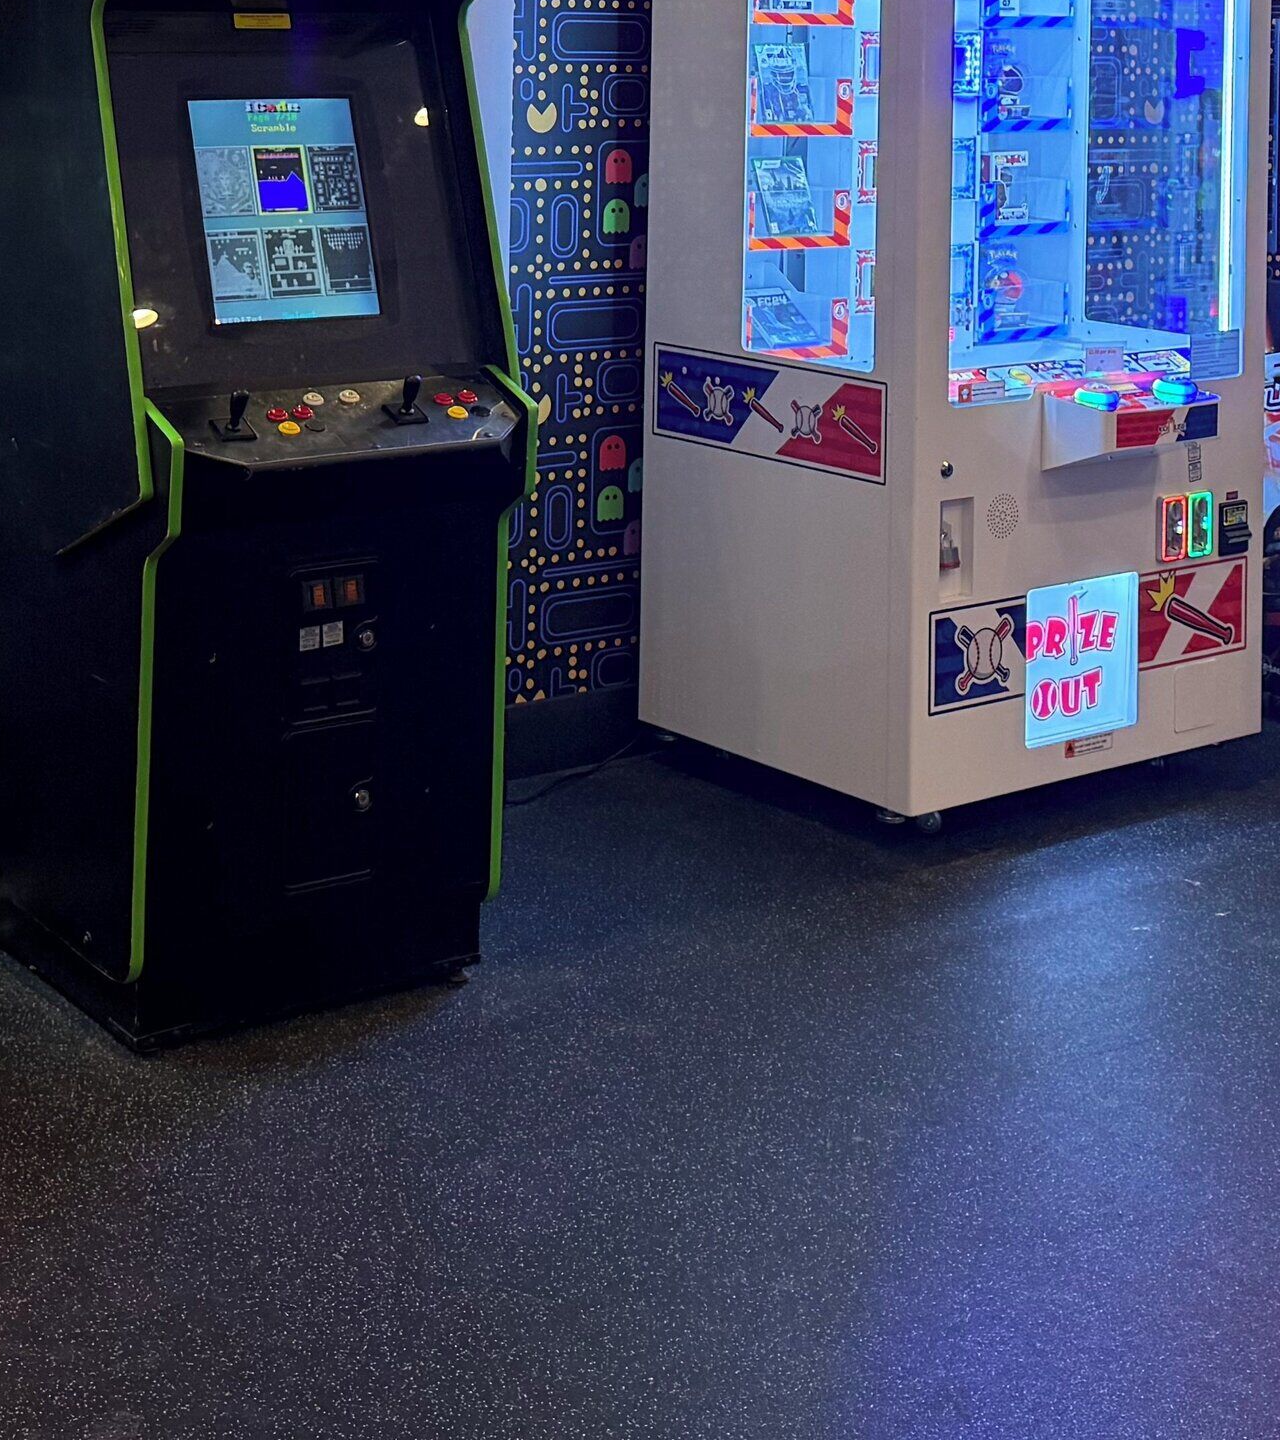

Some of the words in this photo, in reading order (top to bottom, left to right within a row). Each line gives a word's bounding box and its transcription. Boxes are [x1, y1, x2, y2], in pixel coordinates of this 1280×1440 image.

[251, 123, 296, 133] Scramble
[1026, 595, 1120, 665] PRIZE
[1031, 666, 1103, 720] OUT
